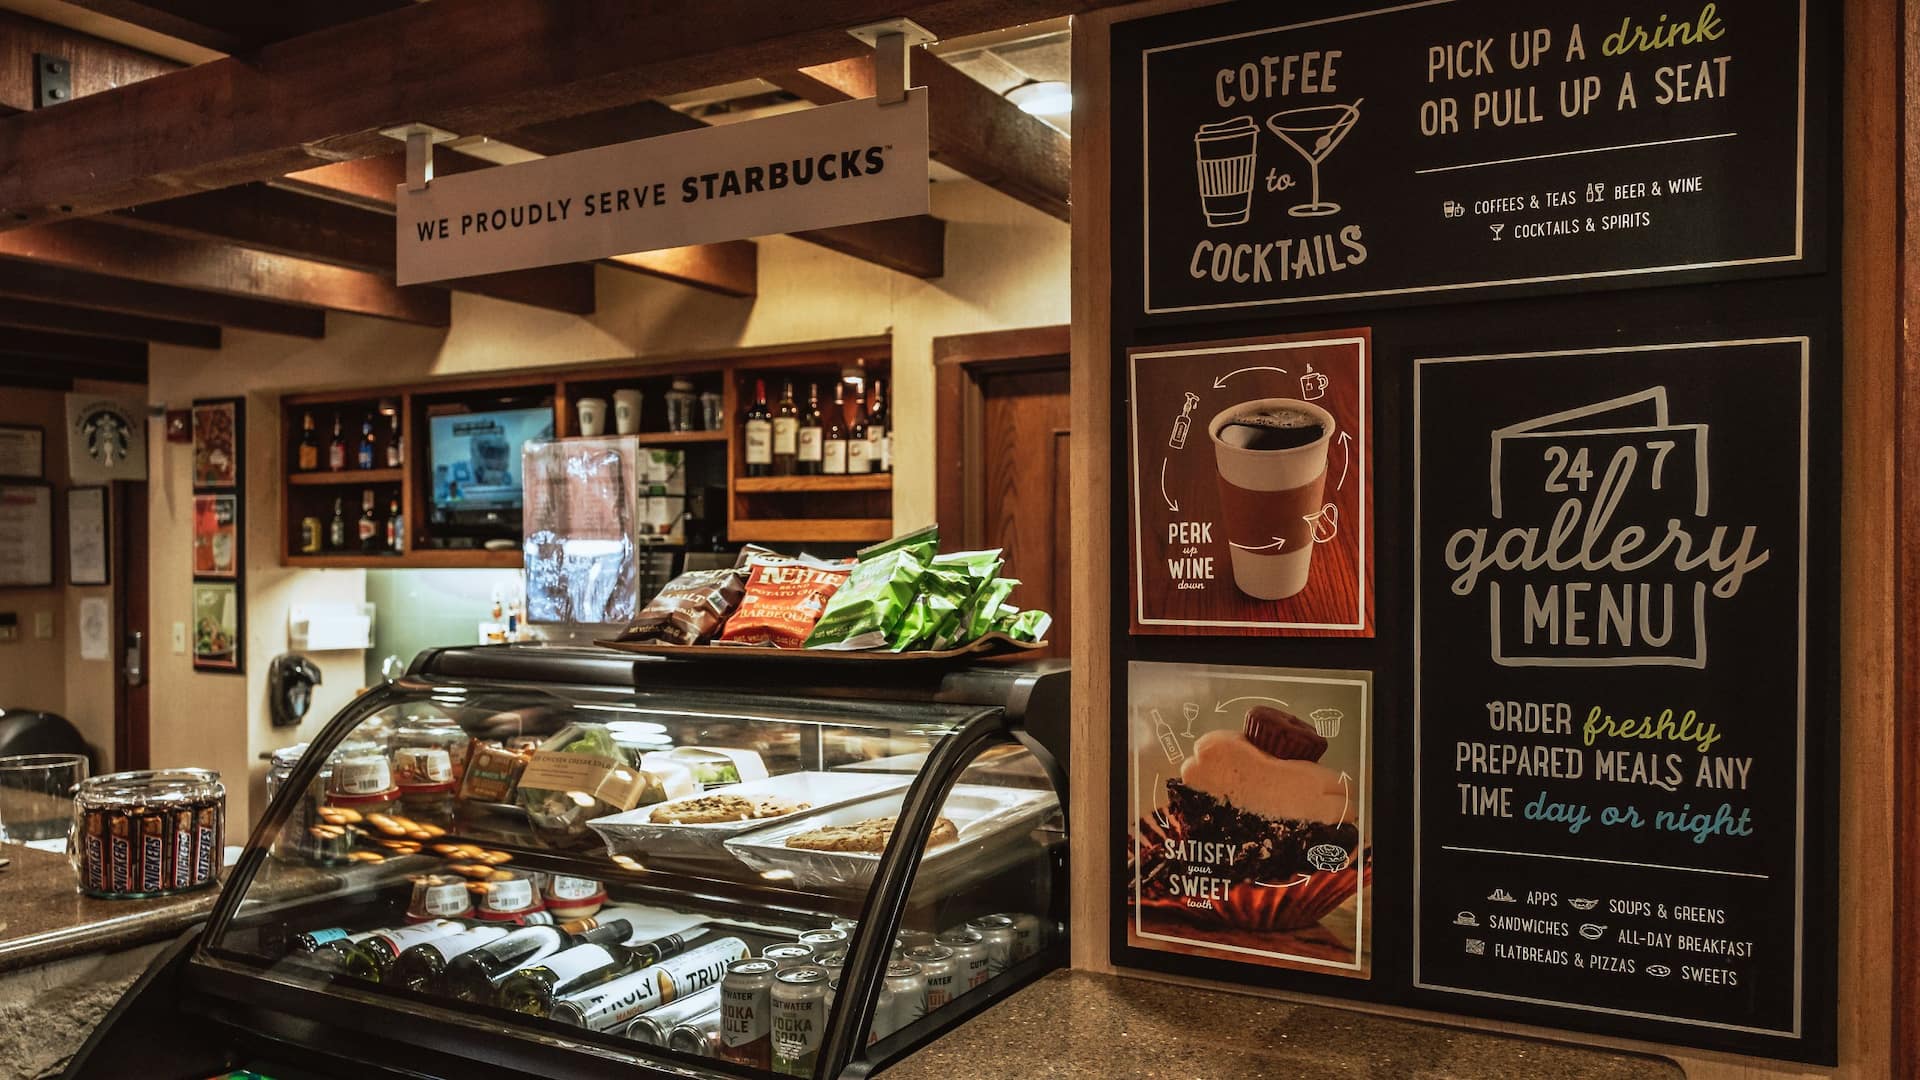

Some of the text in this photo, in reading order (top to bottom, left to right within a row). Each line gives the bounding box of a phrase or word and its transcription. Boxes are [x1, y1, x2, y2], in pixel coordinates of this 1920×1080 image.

[1428, 4, 1726, 83] PICK UP A drink
[1215, 50, 1344, 108] COFFEE
[1420, 55, 1732, 136] OR PULL UP A SEAT
[1265, 167, 1296, 193] to
[1474, 176, 1703, 215] COFFEES & TEAS BEER & WINE
[416, 218, 450, 243] WE
[461, 197, 572, 236] PROUDLY
[584, 183, 666, 218] SERVE
[1514, 211, 1650, 239] COCKTAILS & SPIRITS
[1190, 224, 1367, 284] COCKTAILS
[1646, 440, 1676, 491] 7
[1168, 521, 1213, 543] PERK
[1444, 445, 1770, 599] gallery
[1167, 557, 1215, 579] WINE
[1183, 546, 1198, 557] up
[1178, 579, 1205, 590] down
[1523, 582, 1674, 647] MENU
[1485, 700, 1721, 755] ORDER freshly
[1455, 741, 1753, 792] PREPARED MEALS ANY
[1457, 783, 1753, 844] TIME day or night
[89, 837, 103, 889] SNICKERS
[112, 837, 129, 893] SNICKERS
[144, 836, 161, 891] SNICKERS
[1164, 838, 1236, 866] SATISFY
[1187, 863, 1213, 875] your
[1169, 873, 1232, 901] SWEET
[1186, 897, 1214, 911] tooth
[1526, 890, 1725, 925] APPS SOUPS & GREENS
[1489, 914, 1753, 958] SANDWICHES ALL-DAY BREAKFAST
[1495, 943, 1737, 986] FLATBREADS & PIZZAS SWEETS
[591, 978, 653, 1014] TRULY
[616, 1004, 645, 1021] MANGO
[772, 1016, 813, 1032] VODKA
